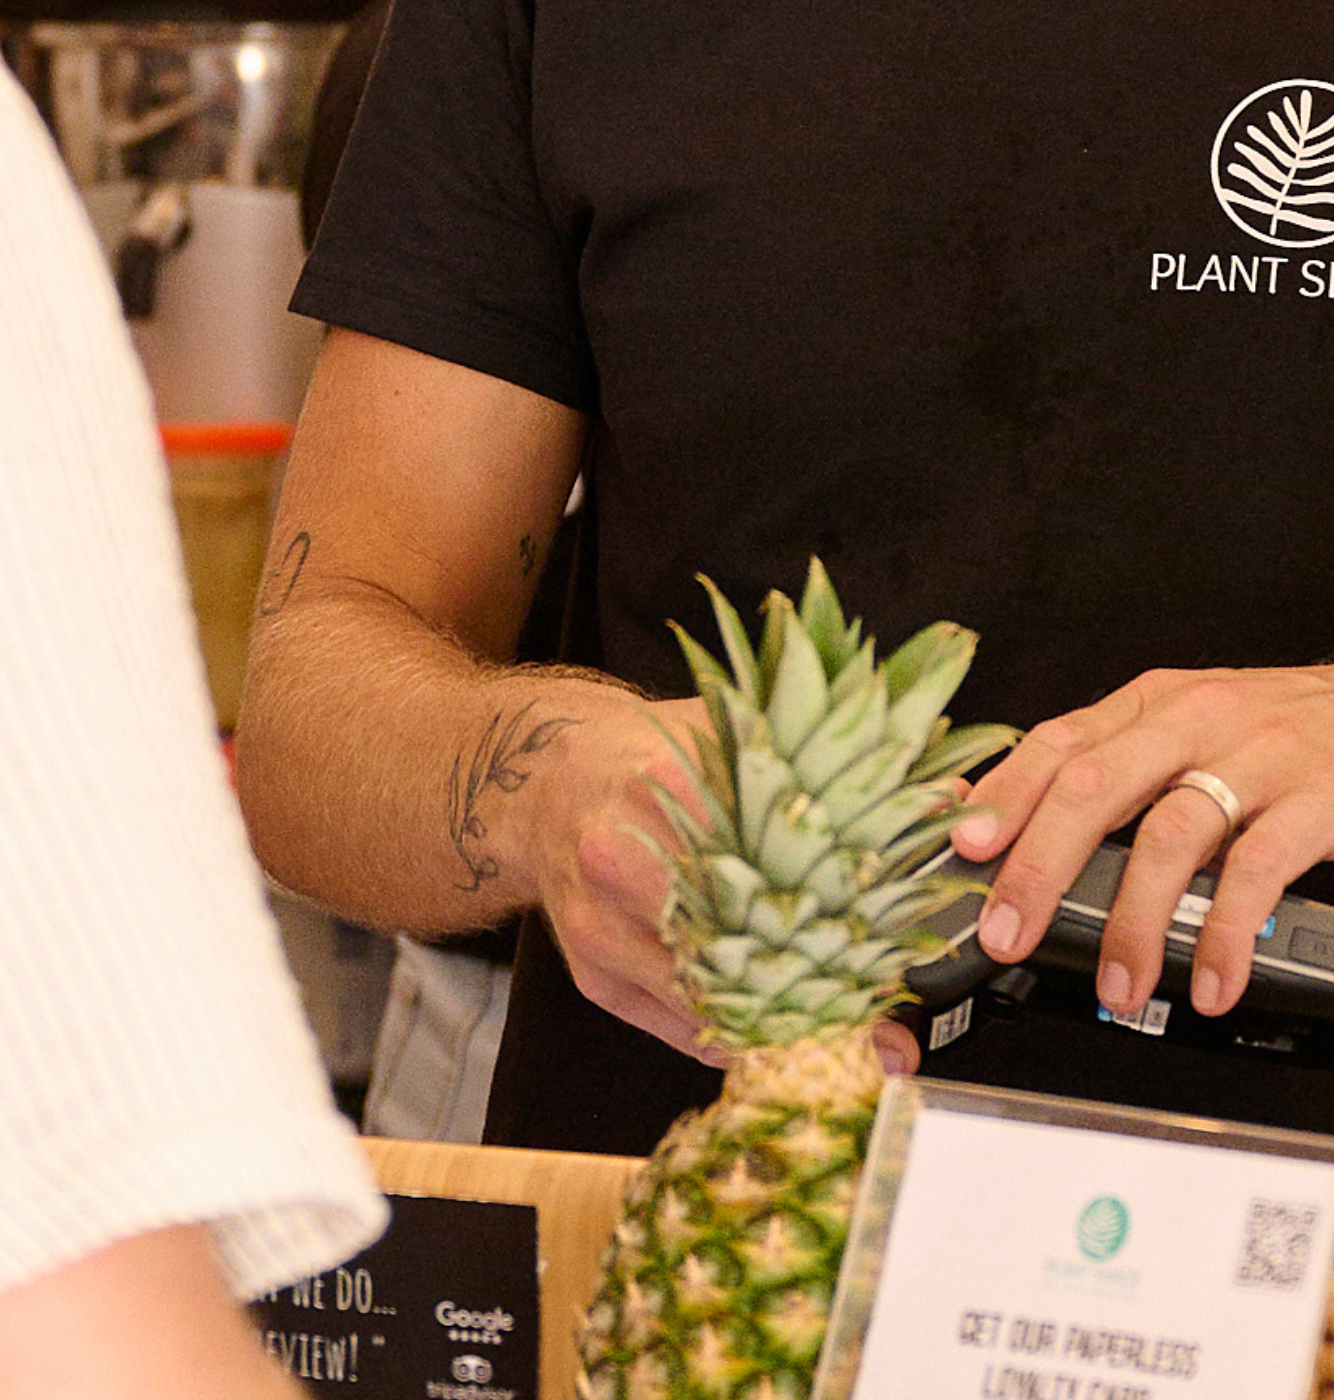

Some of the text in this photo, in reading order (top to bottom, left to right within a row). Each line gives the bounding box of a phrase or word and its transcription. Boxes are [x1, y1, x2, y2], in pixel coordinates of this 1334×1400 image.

[1150, 253, 1289, 295] PLANT
[335, 1267, 397, 1316] DO...
[435, 1300, 514, 1332] Google
[959, 1311, 1200, 1379] GET OUR PAPERLESS
